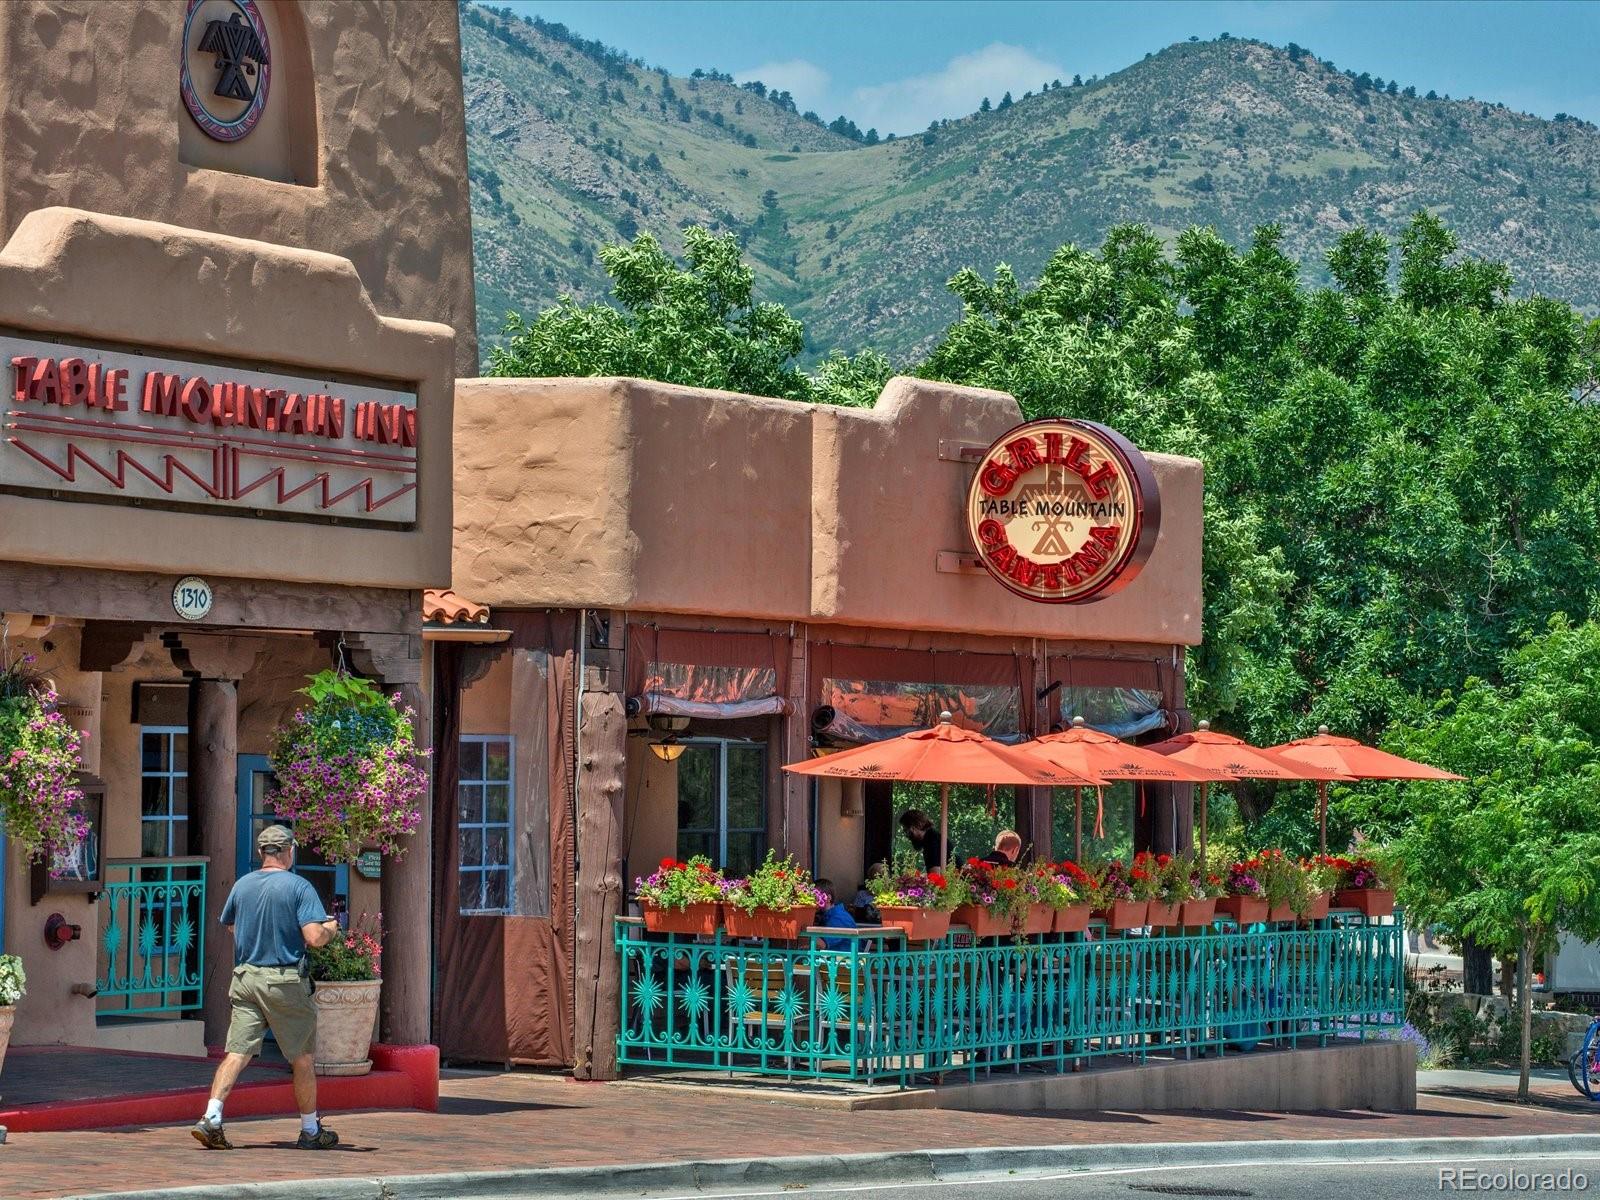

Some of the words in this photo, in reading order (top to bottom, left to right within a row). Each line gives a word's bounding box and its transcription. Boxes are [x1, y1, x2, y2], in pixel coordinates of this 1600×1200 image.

[12, 357, 128, 411] TABLE
[142, 371, 345, 439] MOUNTAIN
[354, 401, 416, 447] INN
[980, 433, 1119, 499] GRILL
[980, 500, 1027, 516] TABLE
[1036, 501, 1125, 517] MOUNTAIN
[978, 519, 1121, 589] CANTINA
[181, 588, 207, 608] 1310
